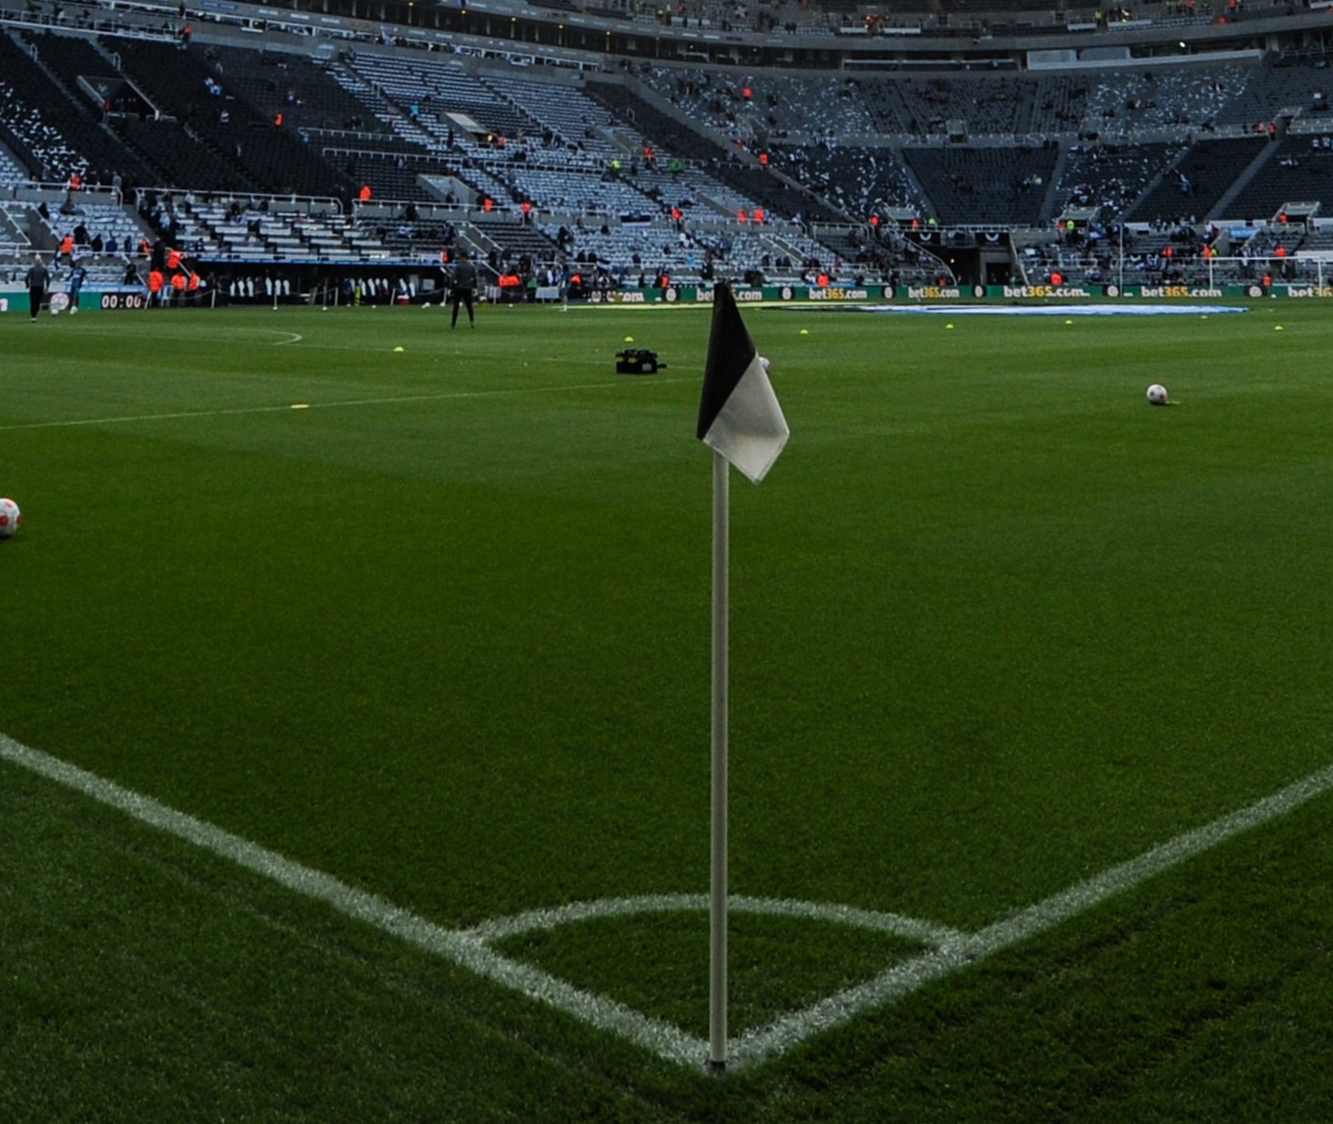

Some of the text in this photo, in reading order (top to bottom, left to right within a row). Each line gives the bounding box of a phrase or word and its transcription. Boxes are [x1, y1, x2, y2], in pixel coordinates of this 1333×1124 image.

[809, 287, 868, 300] bet365.com
[908, 286, 960, 298] bet365.com
[1141, 285, 1223, 297] bet365.com
[100, 294, 142, 309] 00:00
